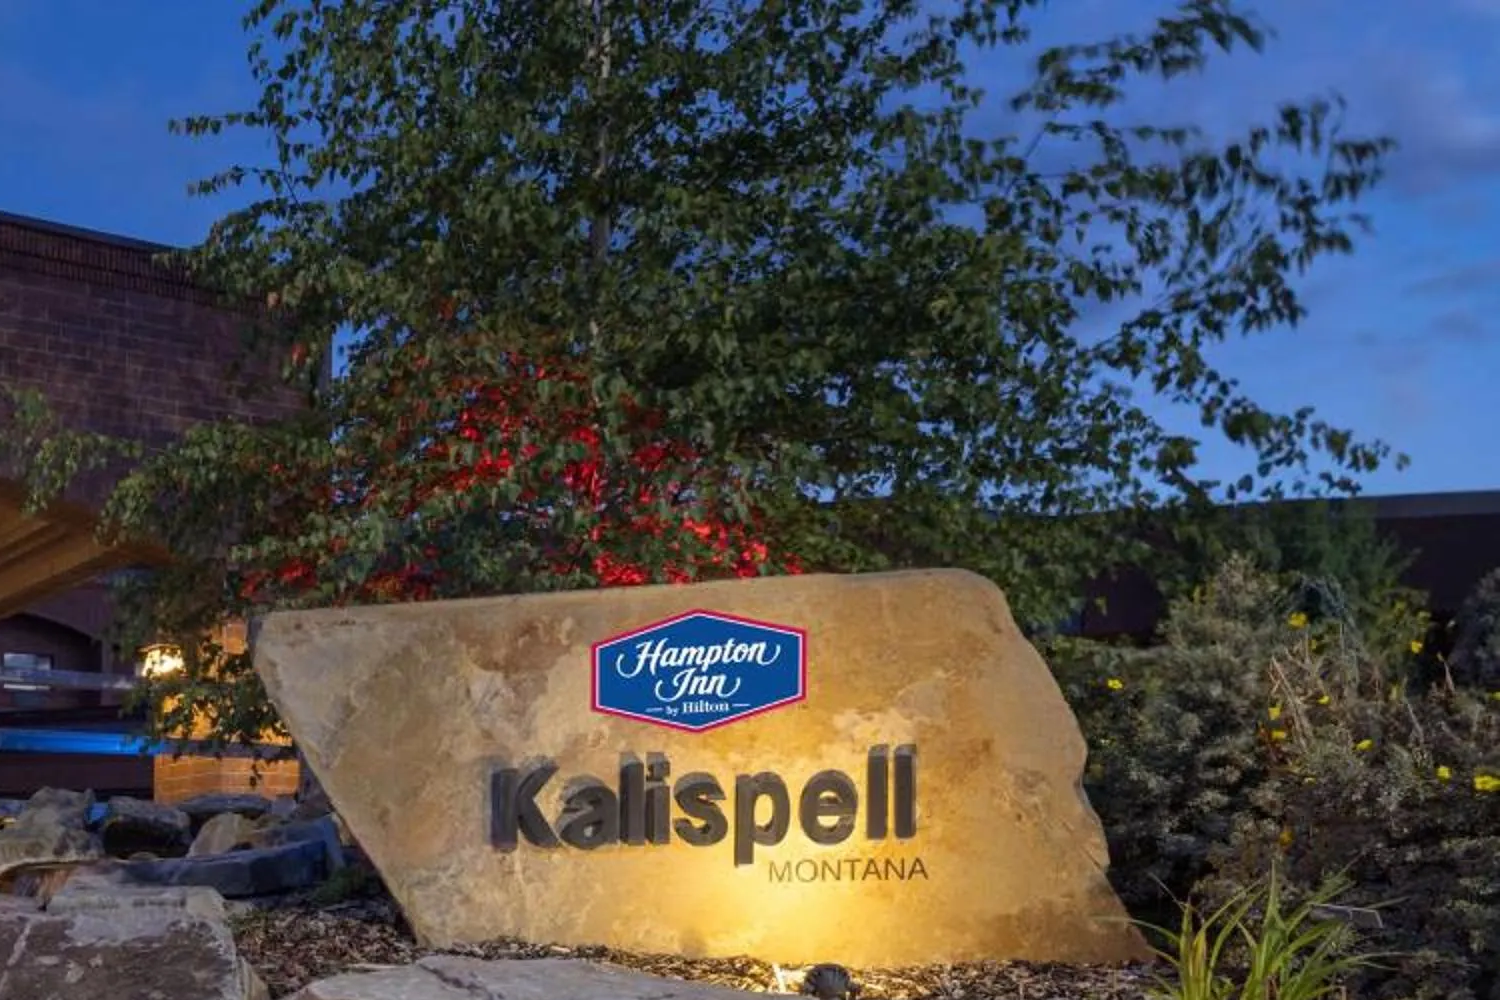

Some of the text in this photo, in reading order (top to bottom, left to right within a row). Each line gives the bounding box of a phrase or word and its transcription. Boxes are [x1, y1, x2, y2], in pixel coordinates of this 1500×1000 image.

[616, 637, 781, 678] Hampton
[655, 667, 741, 702] Inn
[666, 700, 729, 716] by Hilton
[488, 744, 918, 868] Kalispell
[767, 856, 929, 882] MONTANA
